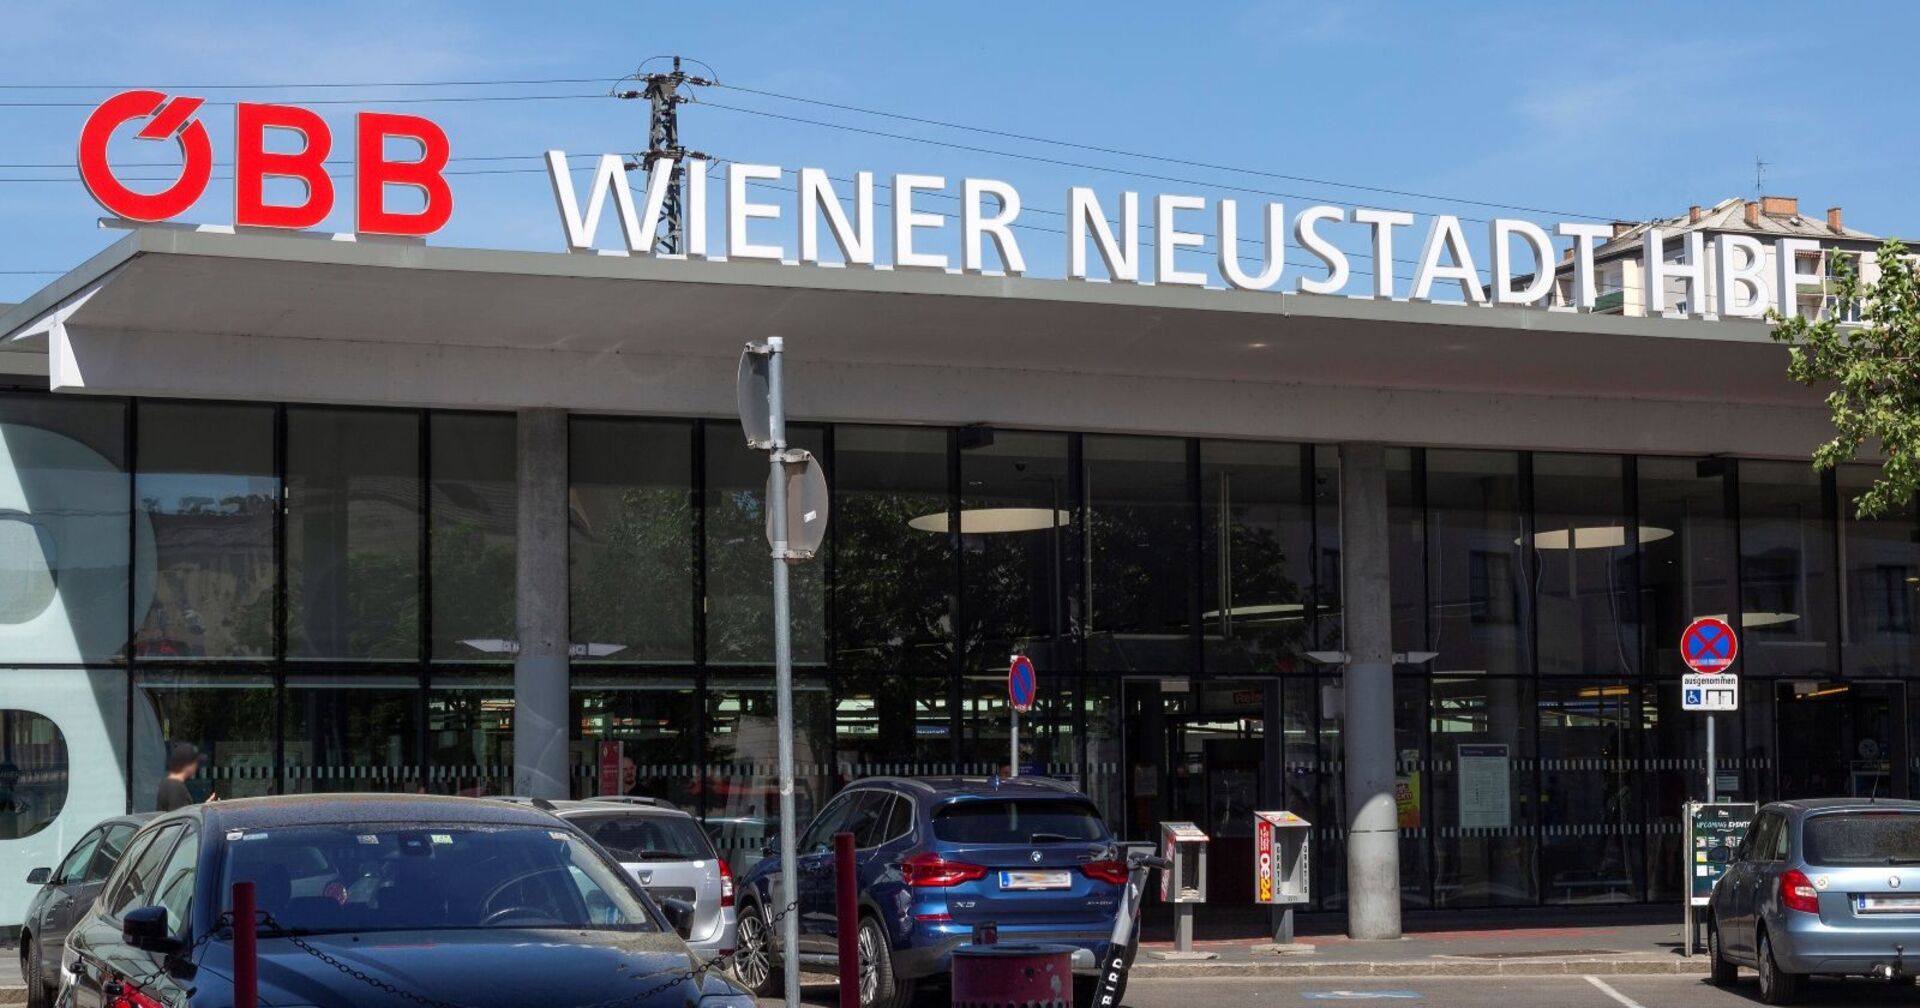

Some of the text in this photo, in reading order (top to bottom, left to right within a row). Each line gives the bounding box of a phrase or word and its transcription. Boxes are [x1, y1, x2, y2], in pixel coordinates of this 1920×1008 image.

[77, 89, 454, 236] ÖBB
[545, 150, 1820, 319] WIENER NEUSTADT HBF
[1684, 678, 1736, 687] ausgenommen
[1101, 958, 1123, 1005] BIRD
